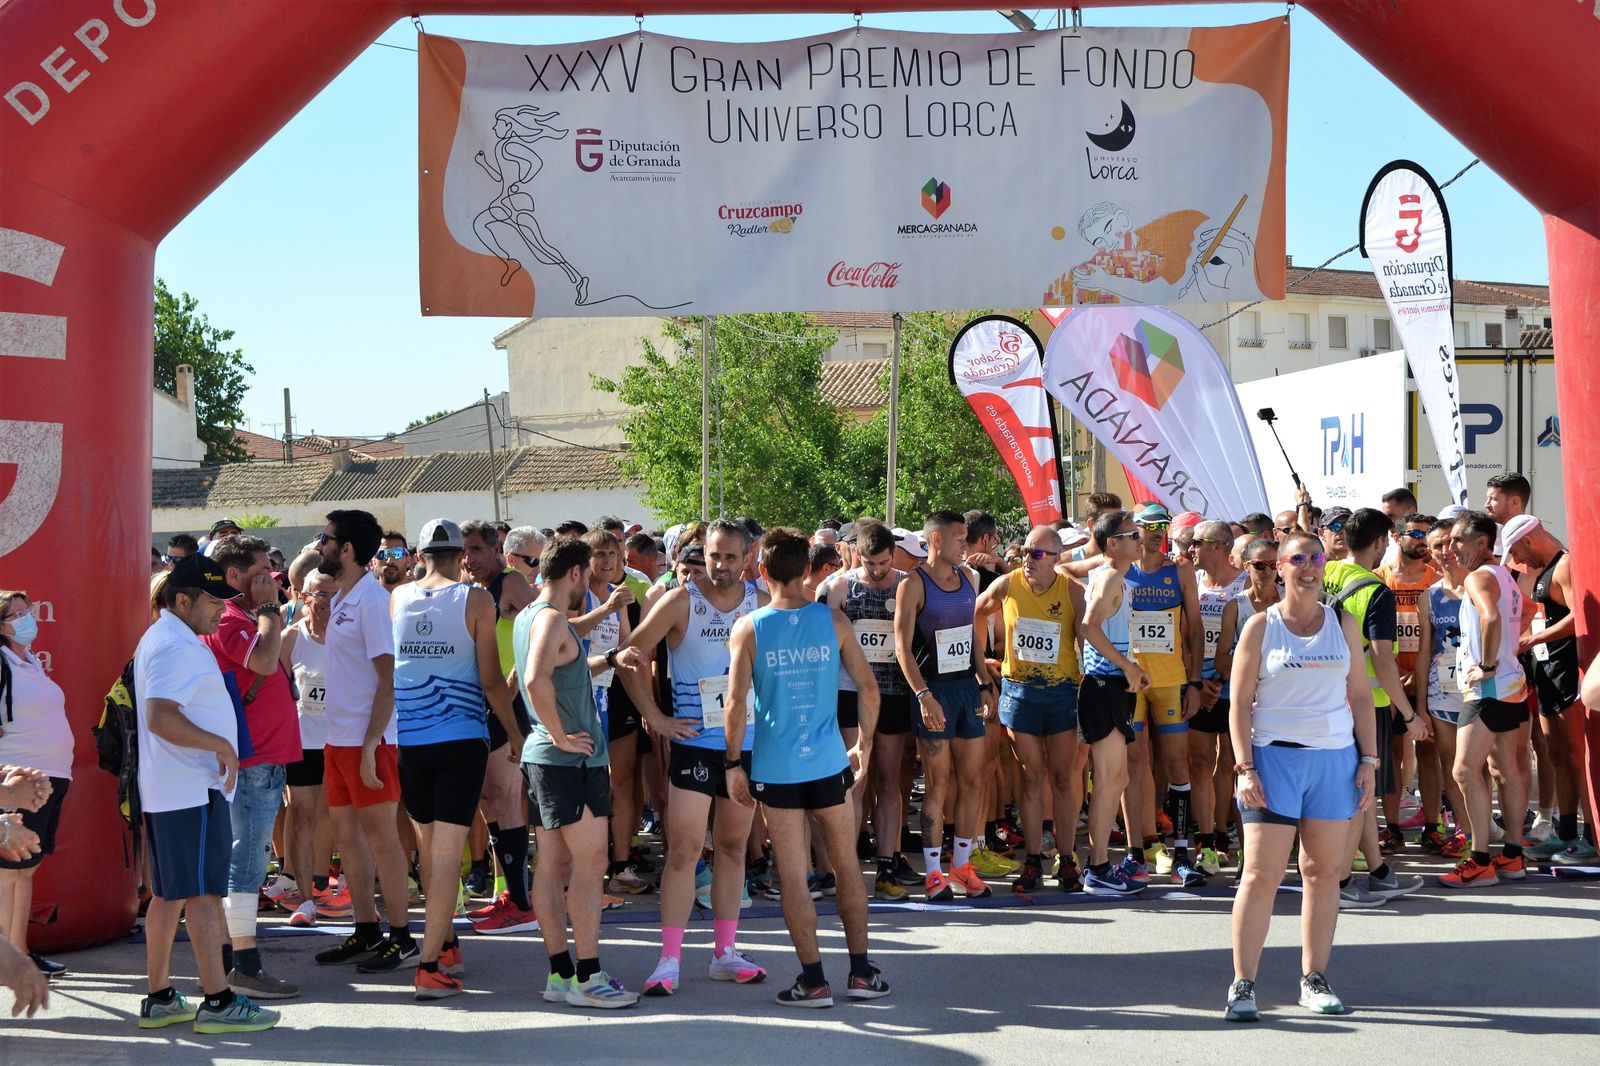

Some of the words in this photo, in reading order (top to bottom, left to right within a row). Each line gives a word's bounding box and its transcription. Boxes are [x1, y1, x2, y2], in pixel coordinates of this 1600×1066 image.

[525, 42, 644, 93] XXXV
[670, 45, 782, 93] GRAN
[807, 42, 962, 90] PREMIO
[988, 45, 1036, 87] DE
[1060, 35, 1196, 90] FONDO
[706, 99, 883, 143] UNIVERSO
[905, 95, 1018, 138] LORCA
[608, 139, 680, 154] Diputación
[609, 154, 625, 167] de
[626, 154, 681, 167] Granada
[1086, 147, 1139, 180] Lorca
[718, 204, 803, 219] Cruzcampo
[727, 223, 768, 237] Radler
[897, 223, 978, 234] MERCAGRANADA
[700, 628, 731, 637] MARA
[1139, 624, 1166, 638] 152
[861, 632, 887, 646] 667
[1017, 634, 1054, 650] 3083
[400, 645, 455, 655] MARACENA
[947, 640, 970, 656] 403
